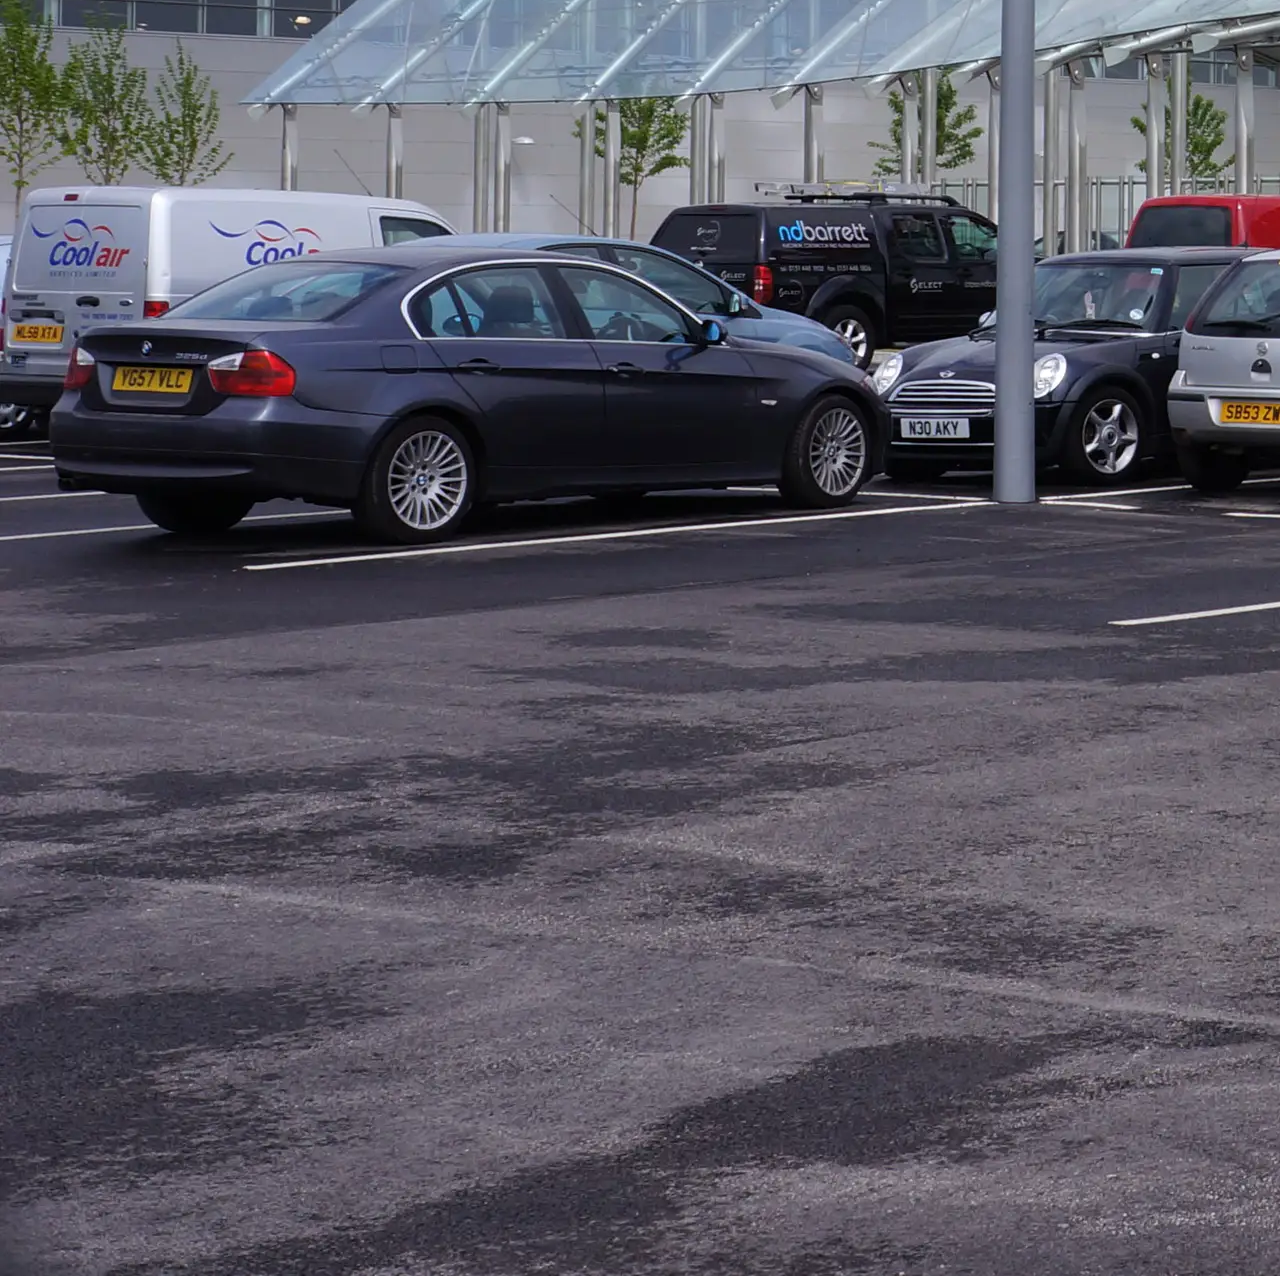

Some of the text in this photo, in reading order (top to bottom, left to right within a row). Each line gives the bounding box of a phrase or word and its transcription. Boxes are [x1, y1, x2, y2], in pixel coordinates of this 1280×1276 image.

[778, 220, 870, 242] ndbarrett
[910, 277, 943, 293] SELECT
[40, 326, 59, 340] XTA
[122, 369, 186, 389] YG57 VLC
[1226, 404, 1259, 421] SB53
[909, 421, 959, 436] N30 AKY
